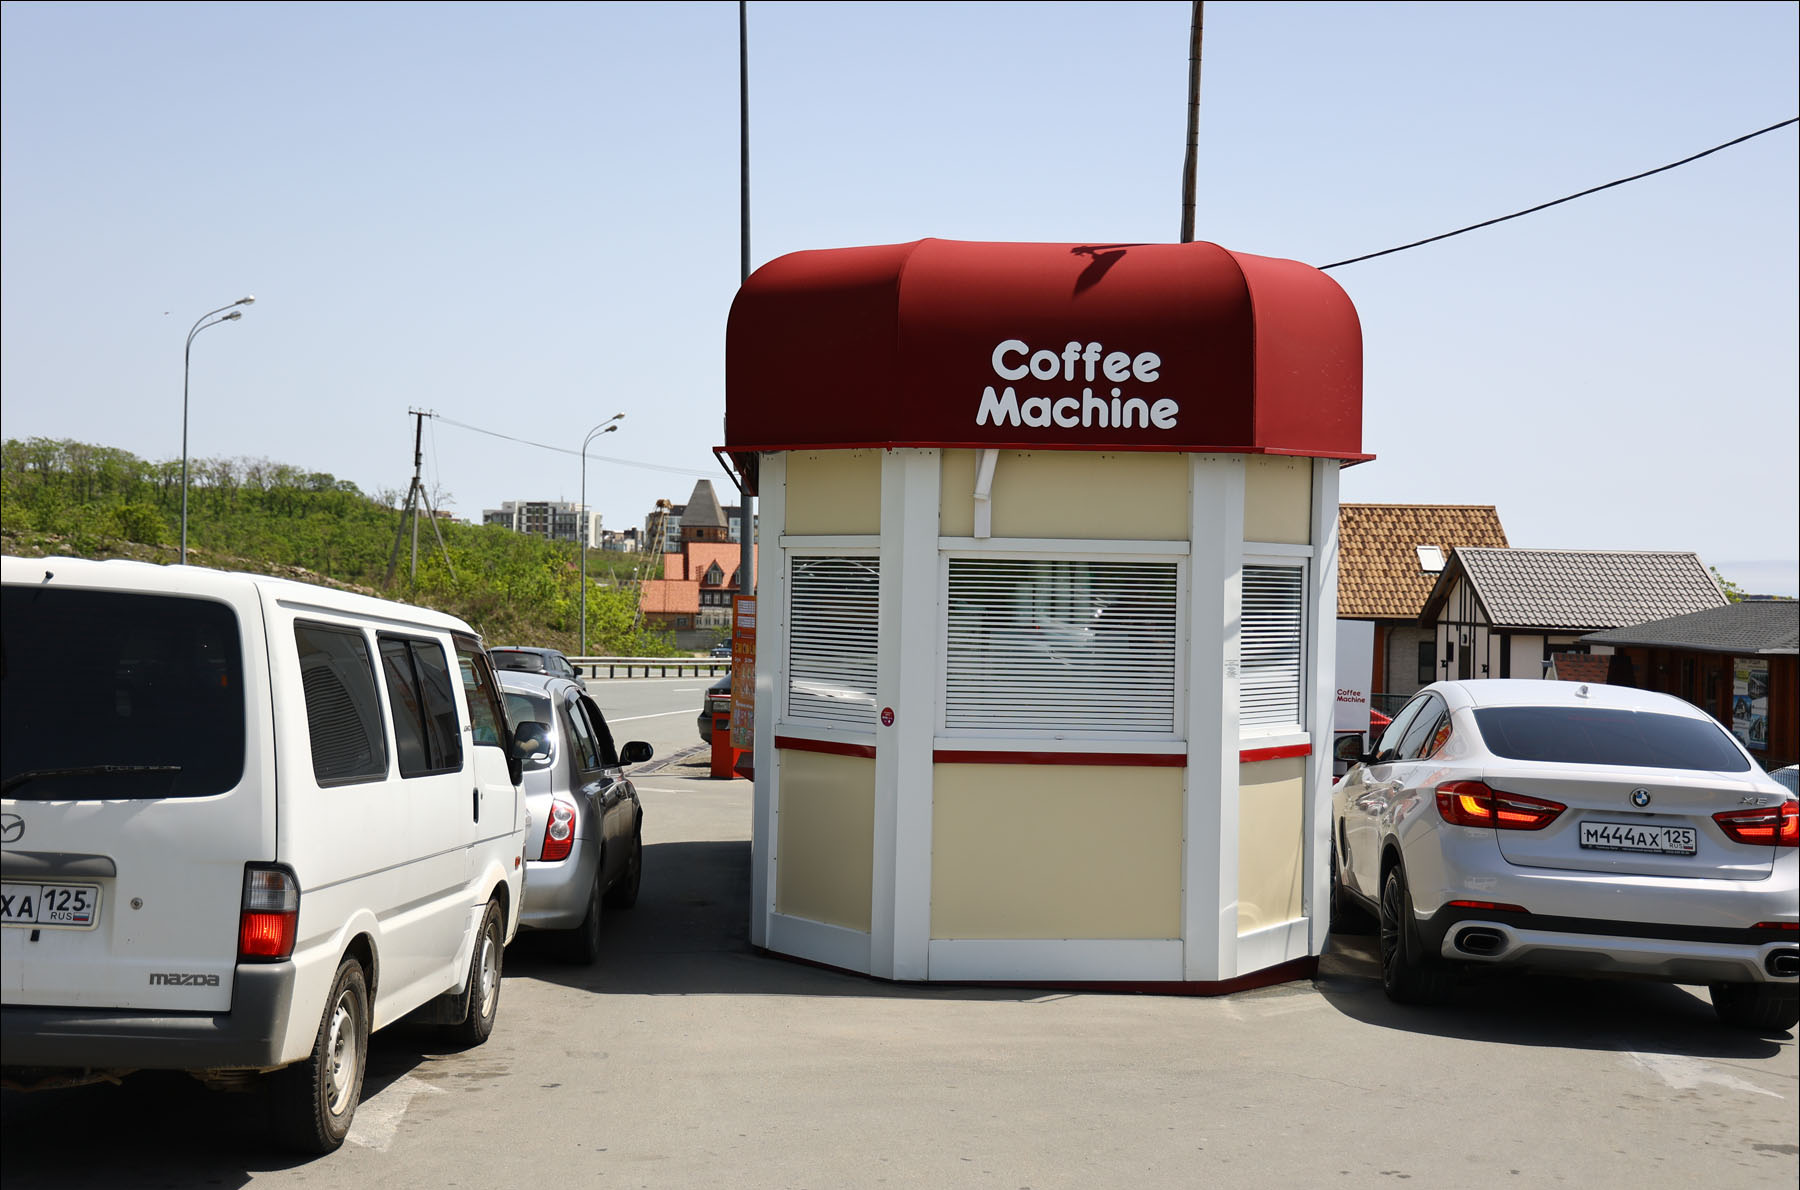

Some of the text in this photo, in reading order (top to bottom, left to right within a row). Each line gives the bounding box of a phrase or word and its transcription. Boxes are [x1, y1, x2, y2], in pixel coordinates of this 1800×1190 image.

[991, 339, 1161, 382] Coffee
[975, 386, 1179, 429] Machine
[1337, 688, 1361, 697] Coffee
[1336, 696, 1366, 704] Machine
[1663, 829, 1691, 844] 125
[44, 889, 86, 912] 125
[50, 911, 73, 921] RUS
[149, 972, 220, 986] mazda
